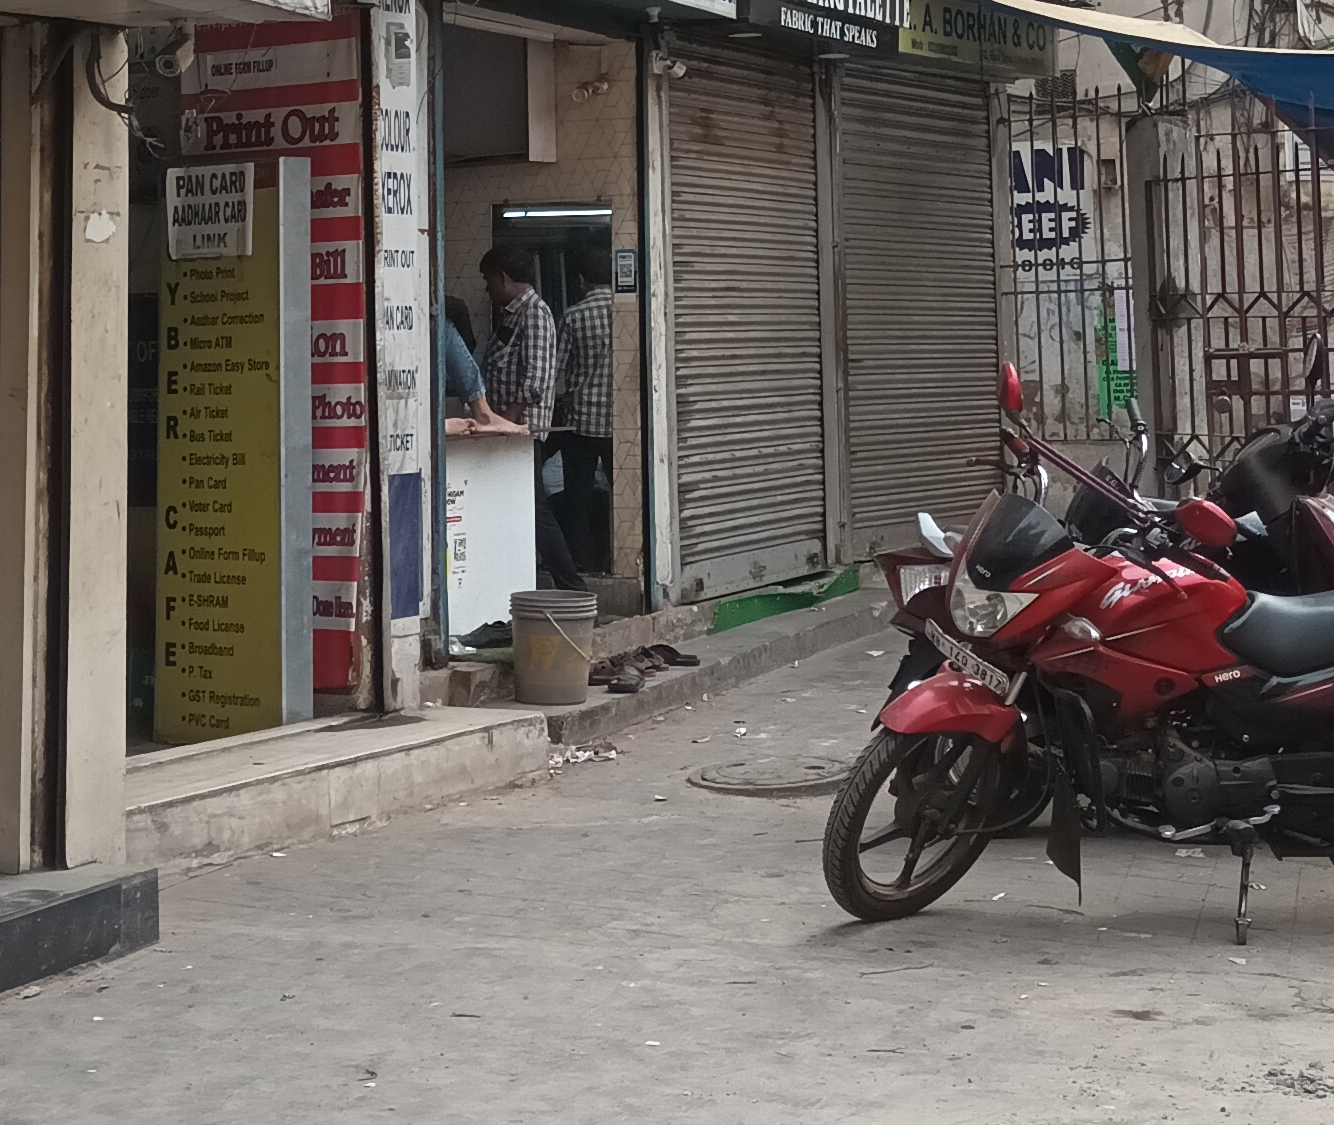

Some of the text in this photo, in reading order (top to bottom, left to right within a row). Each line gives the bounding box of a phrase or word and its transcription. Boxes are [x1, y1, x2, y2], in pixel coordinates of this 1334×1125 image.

[780, 7, 877, 49] FABRIC THAT SPEAKS
[943, 6, 1007, 45] BORHAN
[1012, 18, 1022, 48] &
[1026, 20, 1046, 52] CO
[203, 106, 340, 152] Print Out
[175, 170, 246, 199] PAN CARD
[172, 198, 247, 227] AADHAAR CARD
[192, 232, 228, 250] LINK
[311, 248, 348, 280] Bill
[383, 250, 415, 268] RINT OUT
[189, 267, 236, 281] Photo Print
[189, 289, 249, 304] School Project
[384, 305, 414, 331] AN CARD
[189, 336, 233, 350] Micro ATM
[189, 358, 270, 374] Amazon Easy Store
[189, 383, 232, 396] Rail Ticket
[189, 406, 229, 419] Air Ticket
[312, 394, 365, 420] Photo
[189, 430, 233, 443] Bus Ticket
[389, 433, 414, 452] TICKET
[189, 453, 229, 469] Electricity
[188, 476, 227, 489] Pan Card
[188, 499, 232, 514] Voter Card
[188, 523, 226, 537] Passport
[188, 547, 266, 565] Online Form Fillup
[188, 570, 247, 586] Trade License
[188, 594, 229, 609] E-SHRAM
[188, 619, 245, 634] Food License
[188, 642, 234, 657] Broadband
[198, 666, 213, 680] Tax
[1214, 669, 1242, 684] Hero
[188, 689, 261, 708] GST Registration
[188, 712, 207, 726] PVC
